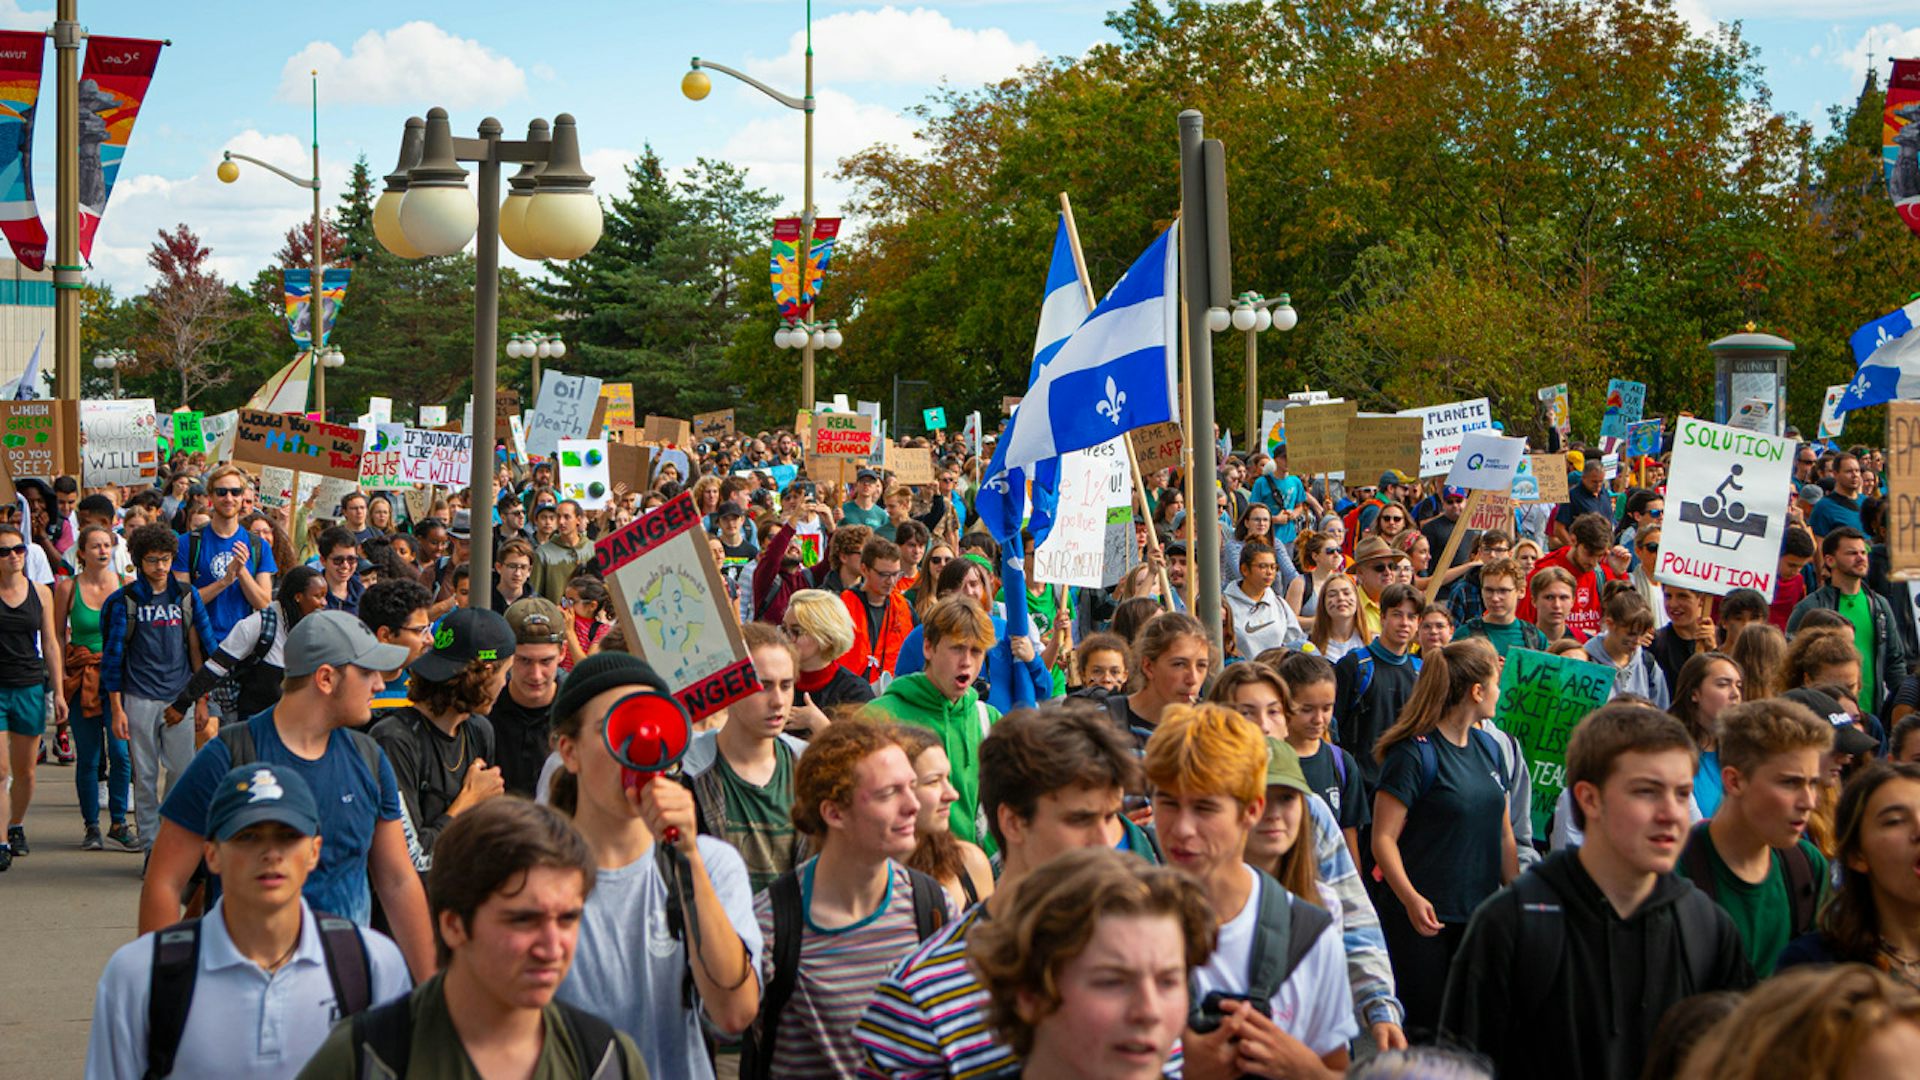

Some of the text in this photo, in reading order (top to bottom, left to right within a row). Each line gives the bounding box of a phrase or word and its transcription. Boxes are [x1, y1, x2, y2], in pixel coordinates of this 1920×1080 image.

[553, 376, 585, 400] Oil
[10, 404, 49, 415] WHICH
[6, 416, 52, 431] GREEN
[535, 412, 582, 435] Death
[827, 416, 856, 429] REAL
[265, 429, 326, 457] Mother
[404, 431, 416, 444] IF
[420, 432, 437, 446] YOU
[816, 428, 871, 443] SOLUTIONS
[1684, 422, 1785, 462] SOLUTION
[9, 450, 51, 460] DO YOU
[816, 442, 871, 455] FOR CANADA
[13, 460, 52, 476] SEE?
[88, 451, 140, 469] WILL
[402, 458, 466, 485] WE WILL
[360, 475, 379, 487] WE
[1470, 512, 1507, 530] VAUT?
[596, 495, 698, 571] DANGER
[1662, 552, 1771, 593] POLLUTION
[1517, 652, 1606, 702] WE ARE
[683, 661, 759, 719] NGER
[1494, 717, 1530, 748] OUR
